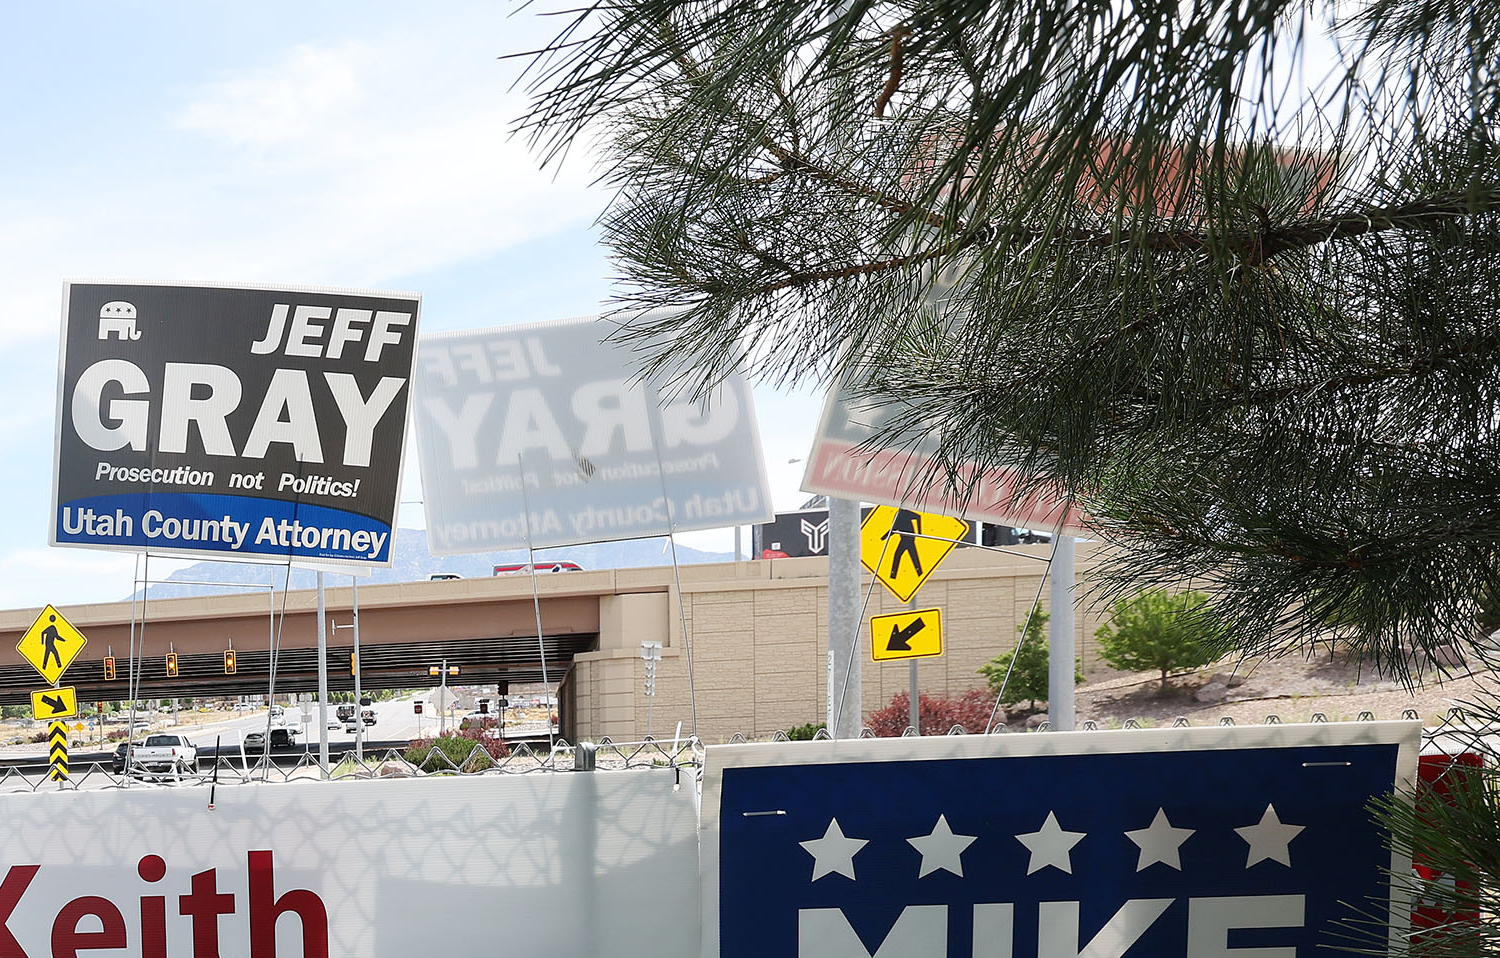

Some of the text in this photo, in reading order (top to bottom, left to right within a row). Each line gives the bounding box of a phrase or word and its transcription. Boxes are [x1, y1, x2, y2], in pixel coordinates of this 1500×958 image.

[251, 303, 411, 362] JEFF
[71, 359, 407, 468] GRAY
[94, 461, 360, 497] Prosecution not Politics!
[62, 505, 387, 559] Utah County Attorney
